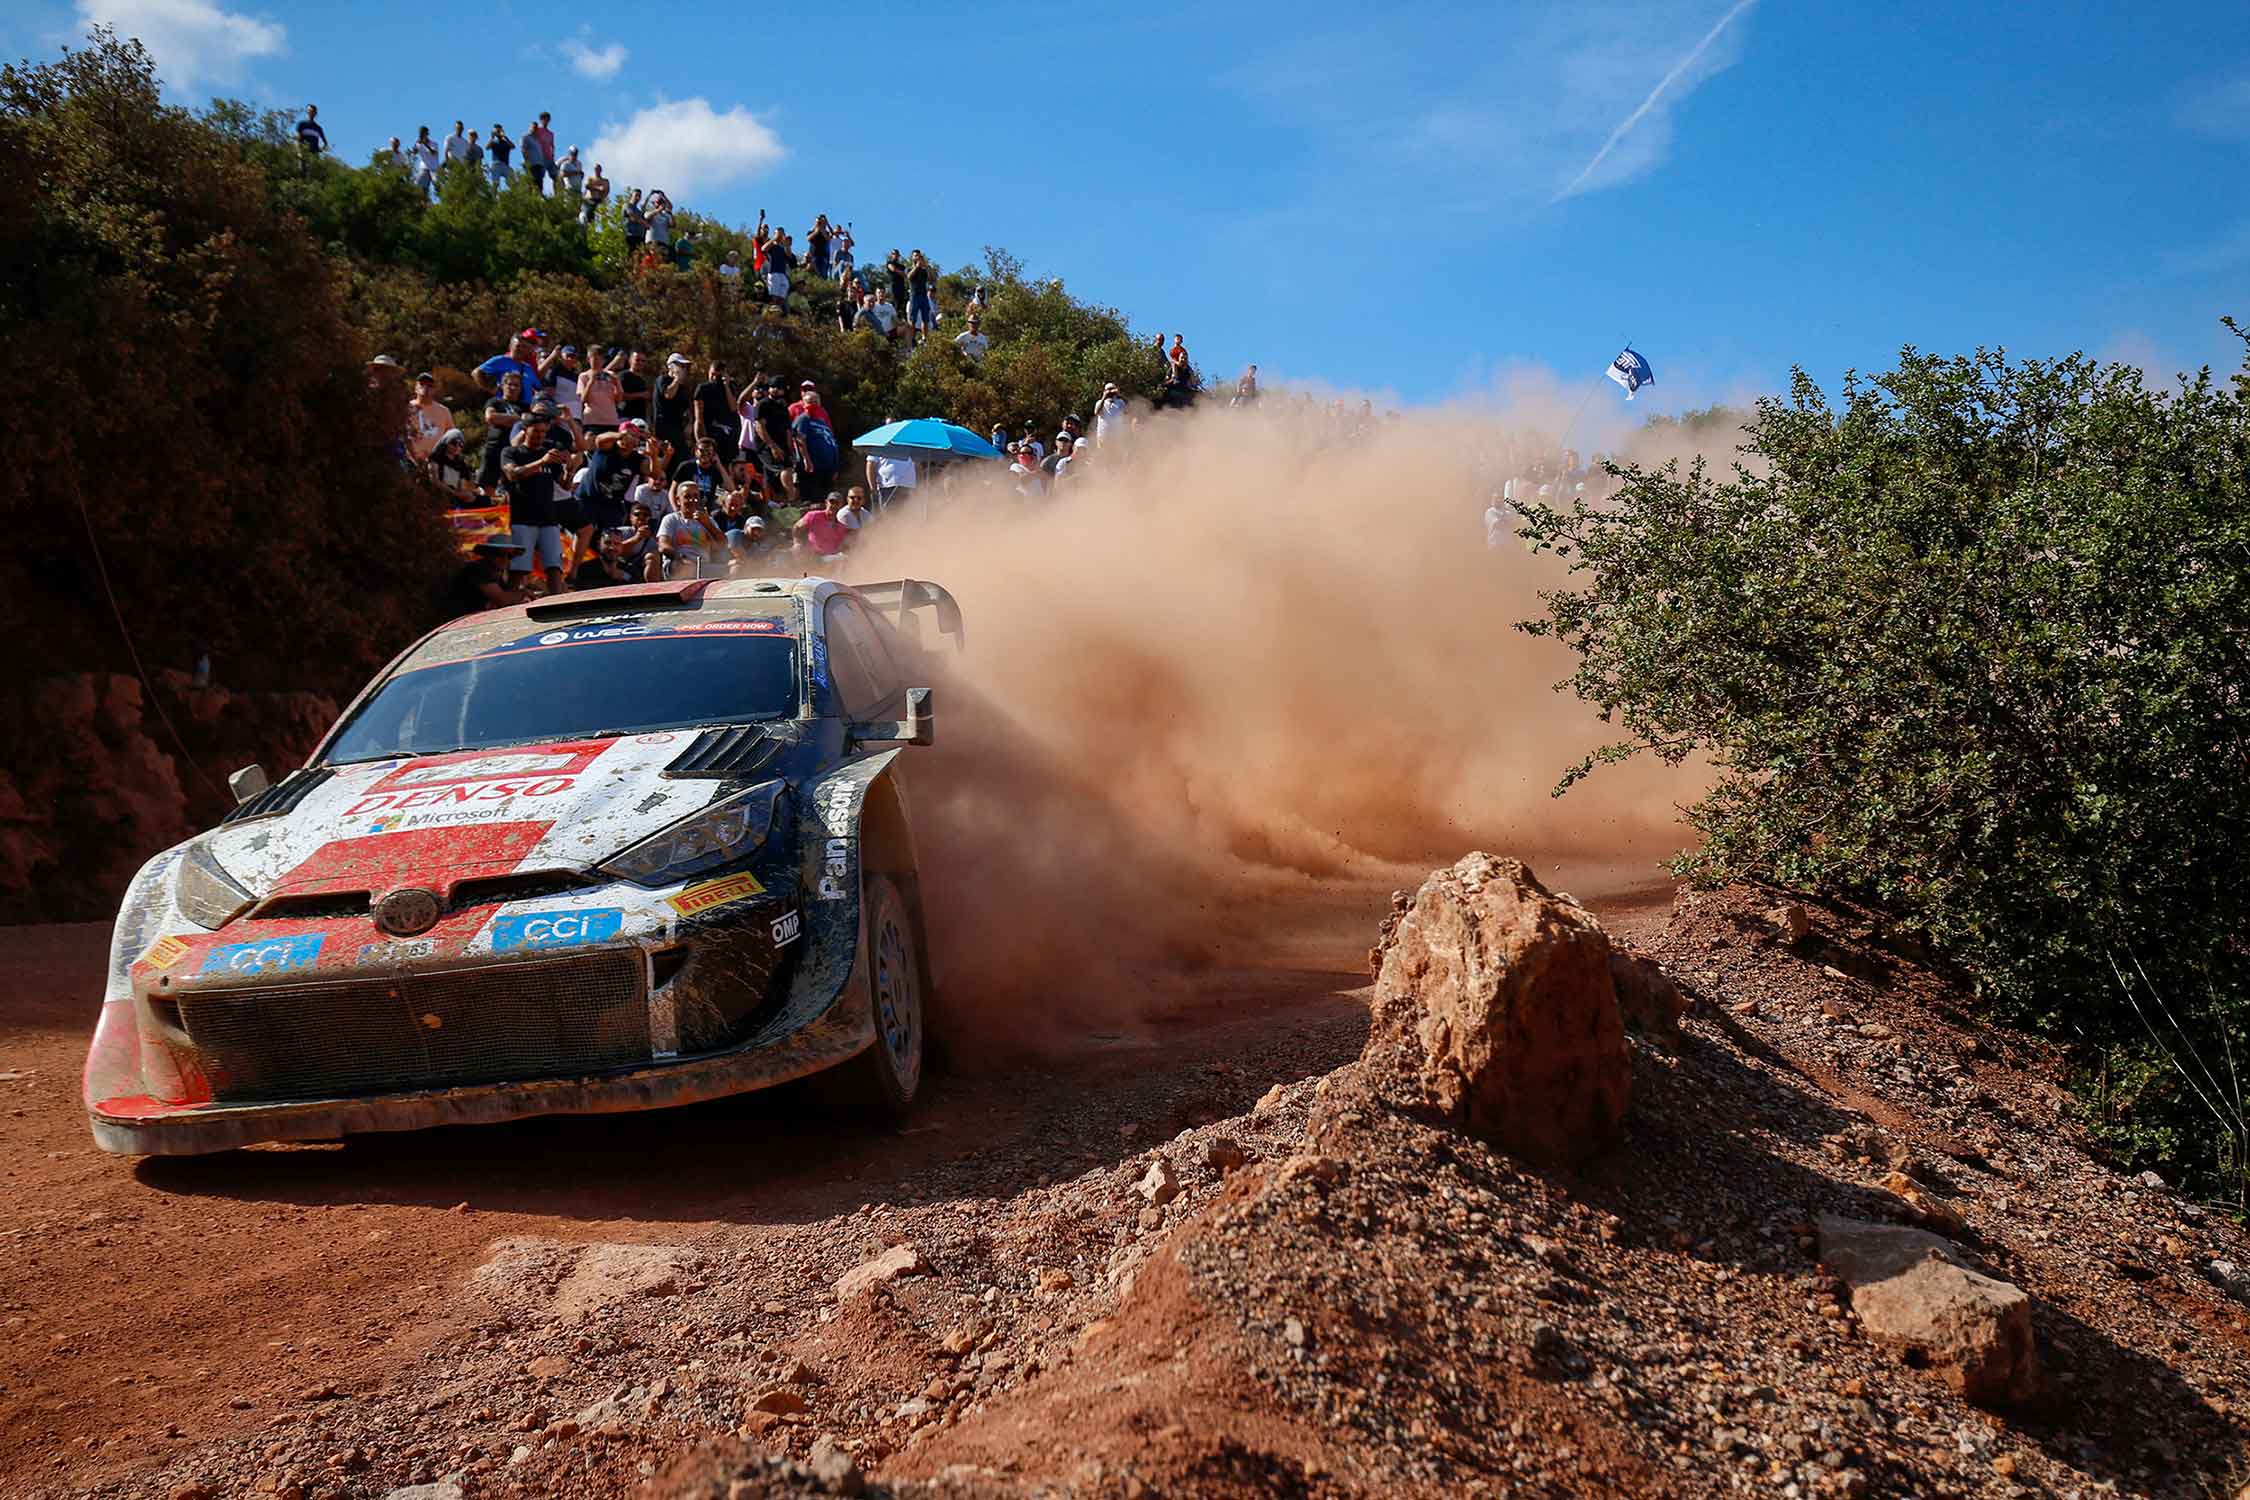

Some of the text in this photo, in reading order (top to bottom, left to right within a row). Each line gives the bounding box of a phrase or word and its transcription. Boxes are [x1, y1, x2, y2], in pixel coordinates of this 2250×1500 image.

[573, 626, 649, 639] WRC
[704, 623, 740, 631] ORDER
[341, 777, 575, 817] DENSO
[407, 807, 509, 827] Microsoft
[674, 876, 755, 911] PIRELLI
[772, 915, 800, 942] OMP
